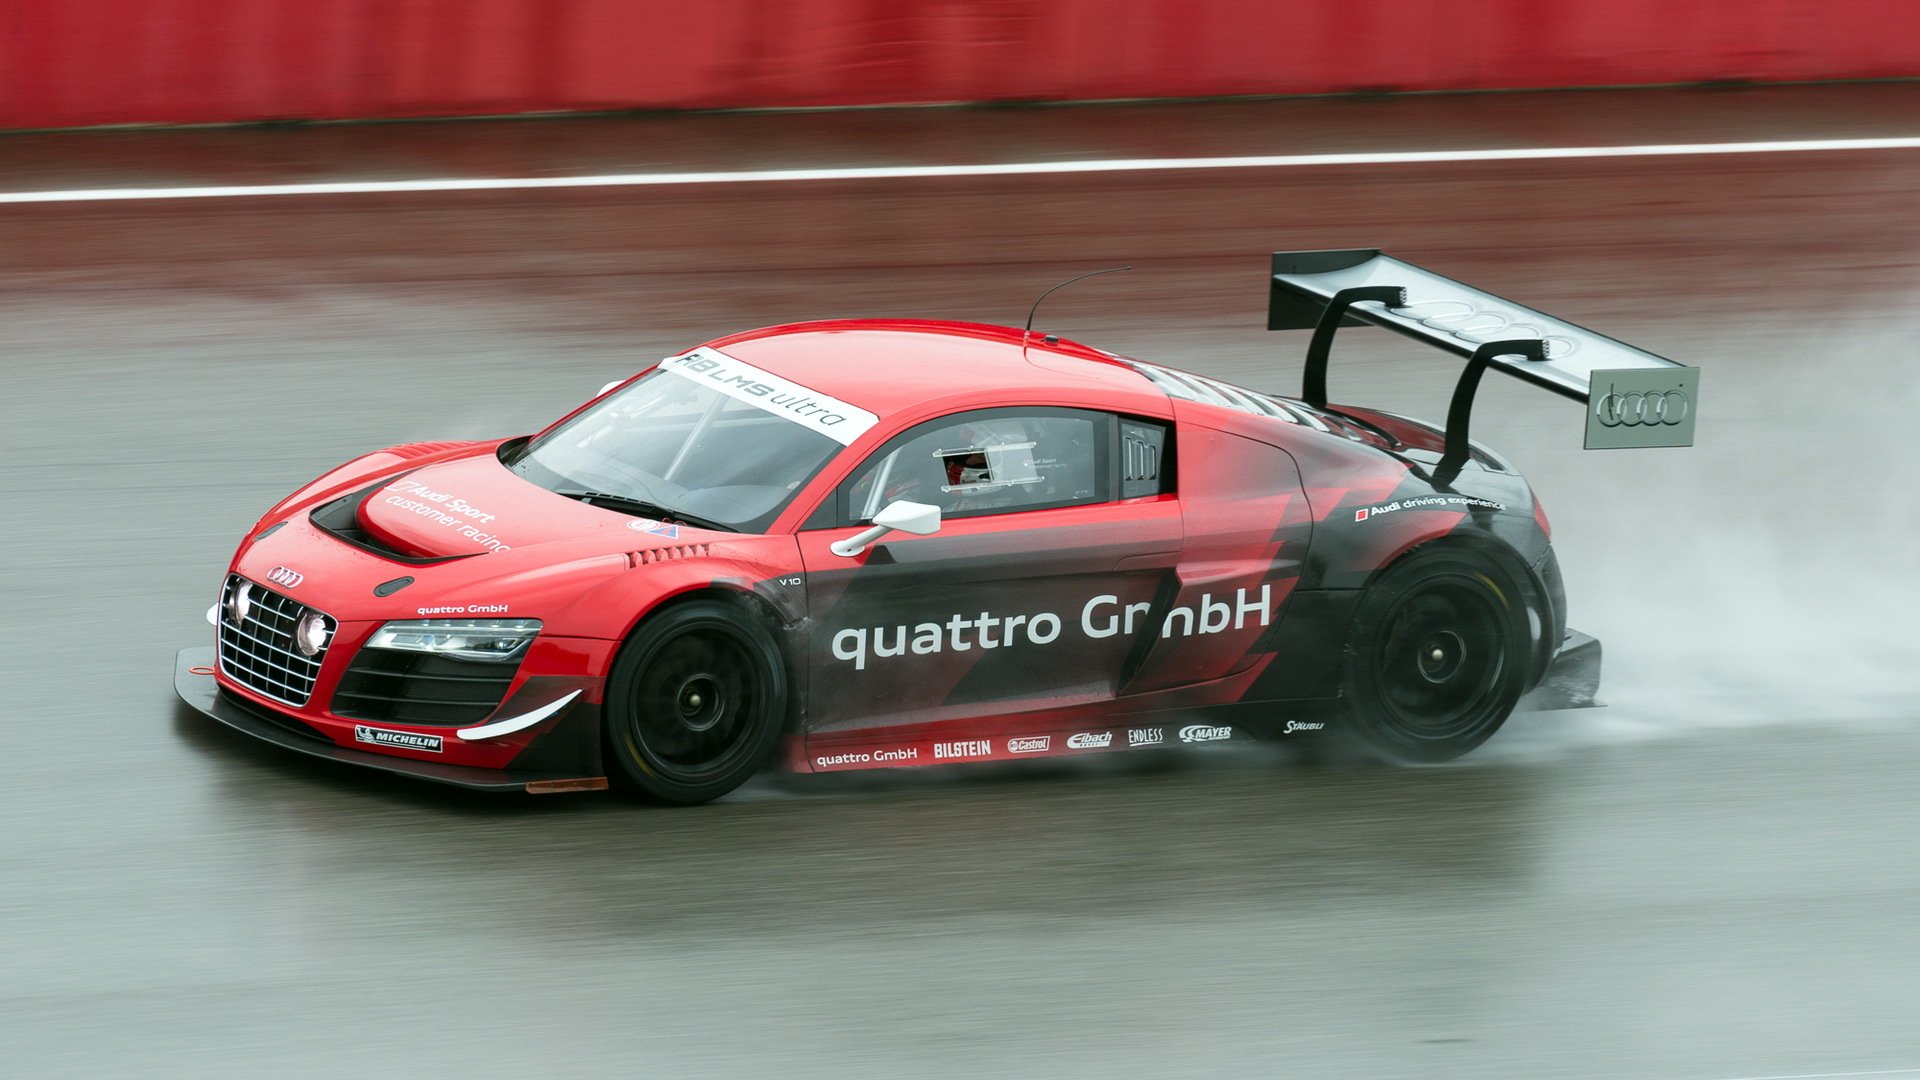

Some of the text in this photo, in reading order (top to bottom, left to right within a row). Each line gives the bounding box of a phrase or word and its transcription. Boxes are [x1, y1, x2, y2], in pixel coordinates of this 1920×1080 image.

[708, 369, 775, 396] LMS
[770, 393, 847, 426] ultra
[385, 495, 463, 526] customer
[408, 486, 496, 524] Audi Sport
[1371, 496, 1507, 516] Audi driving experience
[779, 577, 801, 586] V10
[417, 604, 509, 615] quattro GmbH
[831, 584, 1271, 670] quattro GmbH
[376, 732, 439, 747] MICHELIN
[1066, 732, 1113, 748] Eibach
[1128, 728, 1163, 743] ENDLESS
[1195, 726, 1232, 739] MAYER
[934, 740, 992, 758] BILSTEIN
[1017, 739, 1046, 750] Castrol
[816, 747, 918, 767] quattro GmbH
